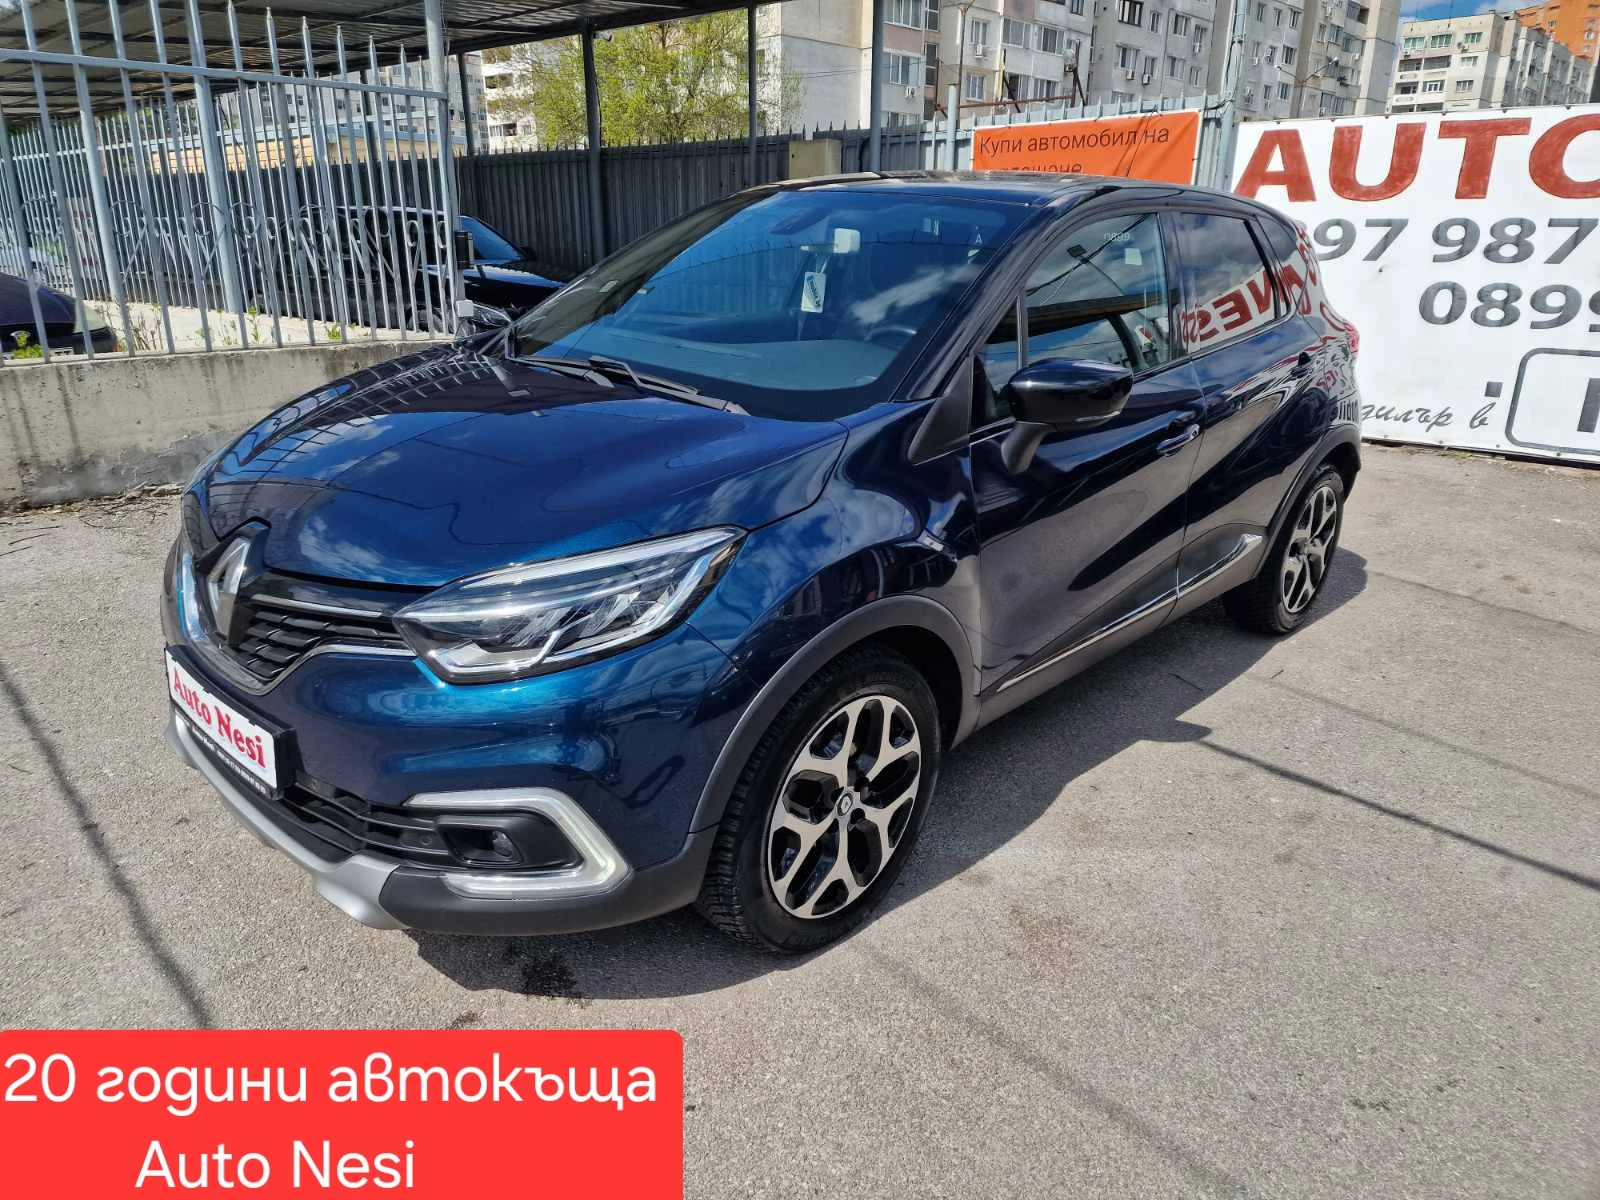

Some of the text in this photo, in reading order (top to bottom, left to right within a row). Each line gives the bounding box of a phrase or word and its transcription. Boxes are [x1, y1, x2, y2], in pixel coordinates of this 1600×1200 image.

[980, 128, 1170, 158] Купи автомобил на
[1235, 115, 1600, 202] AUTO
[1431, 217, 1599, 264] 987
[1418, 281, 1600, 333] 089
[173, 668, 212, 726] Auto
[214, 705, 266, 769] Nesi
